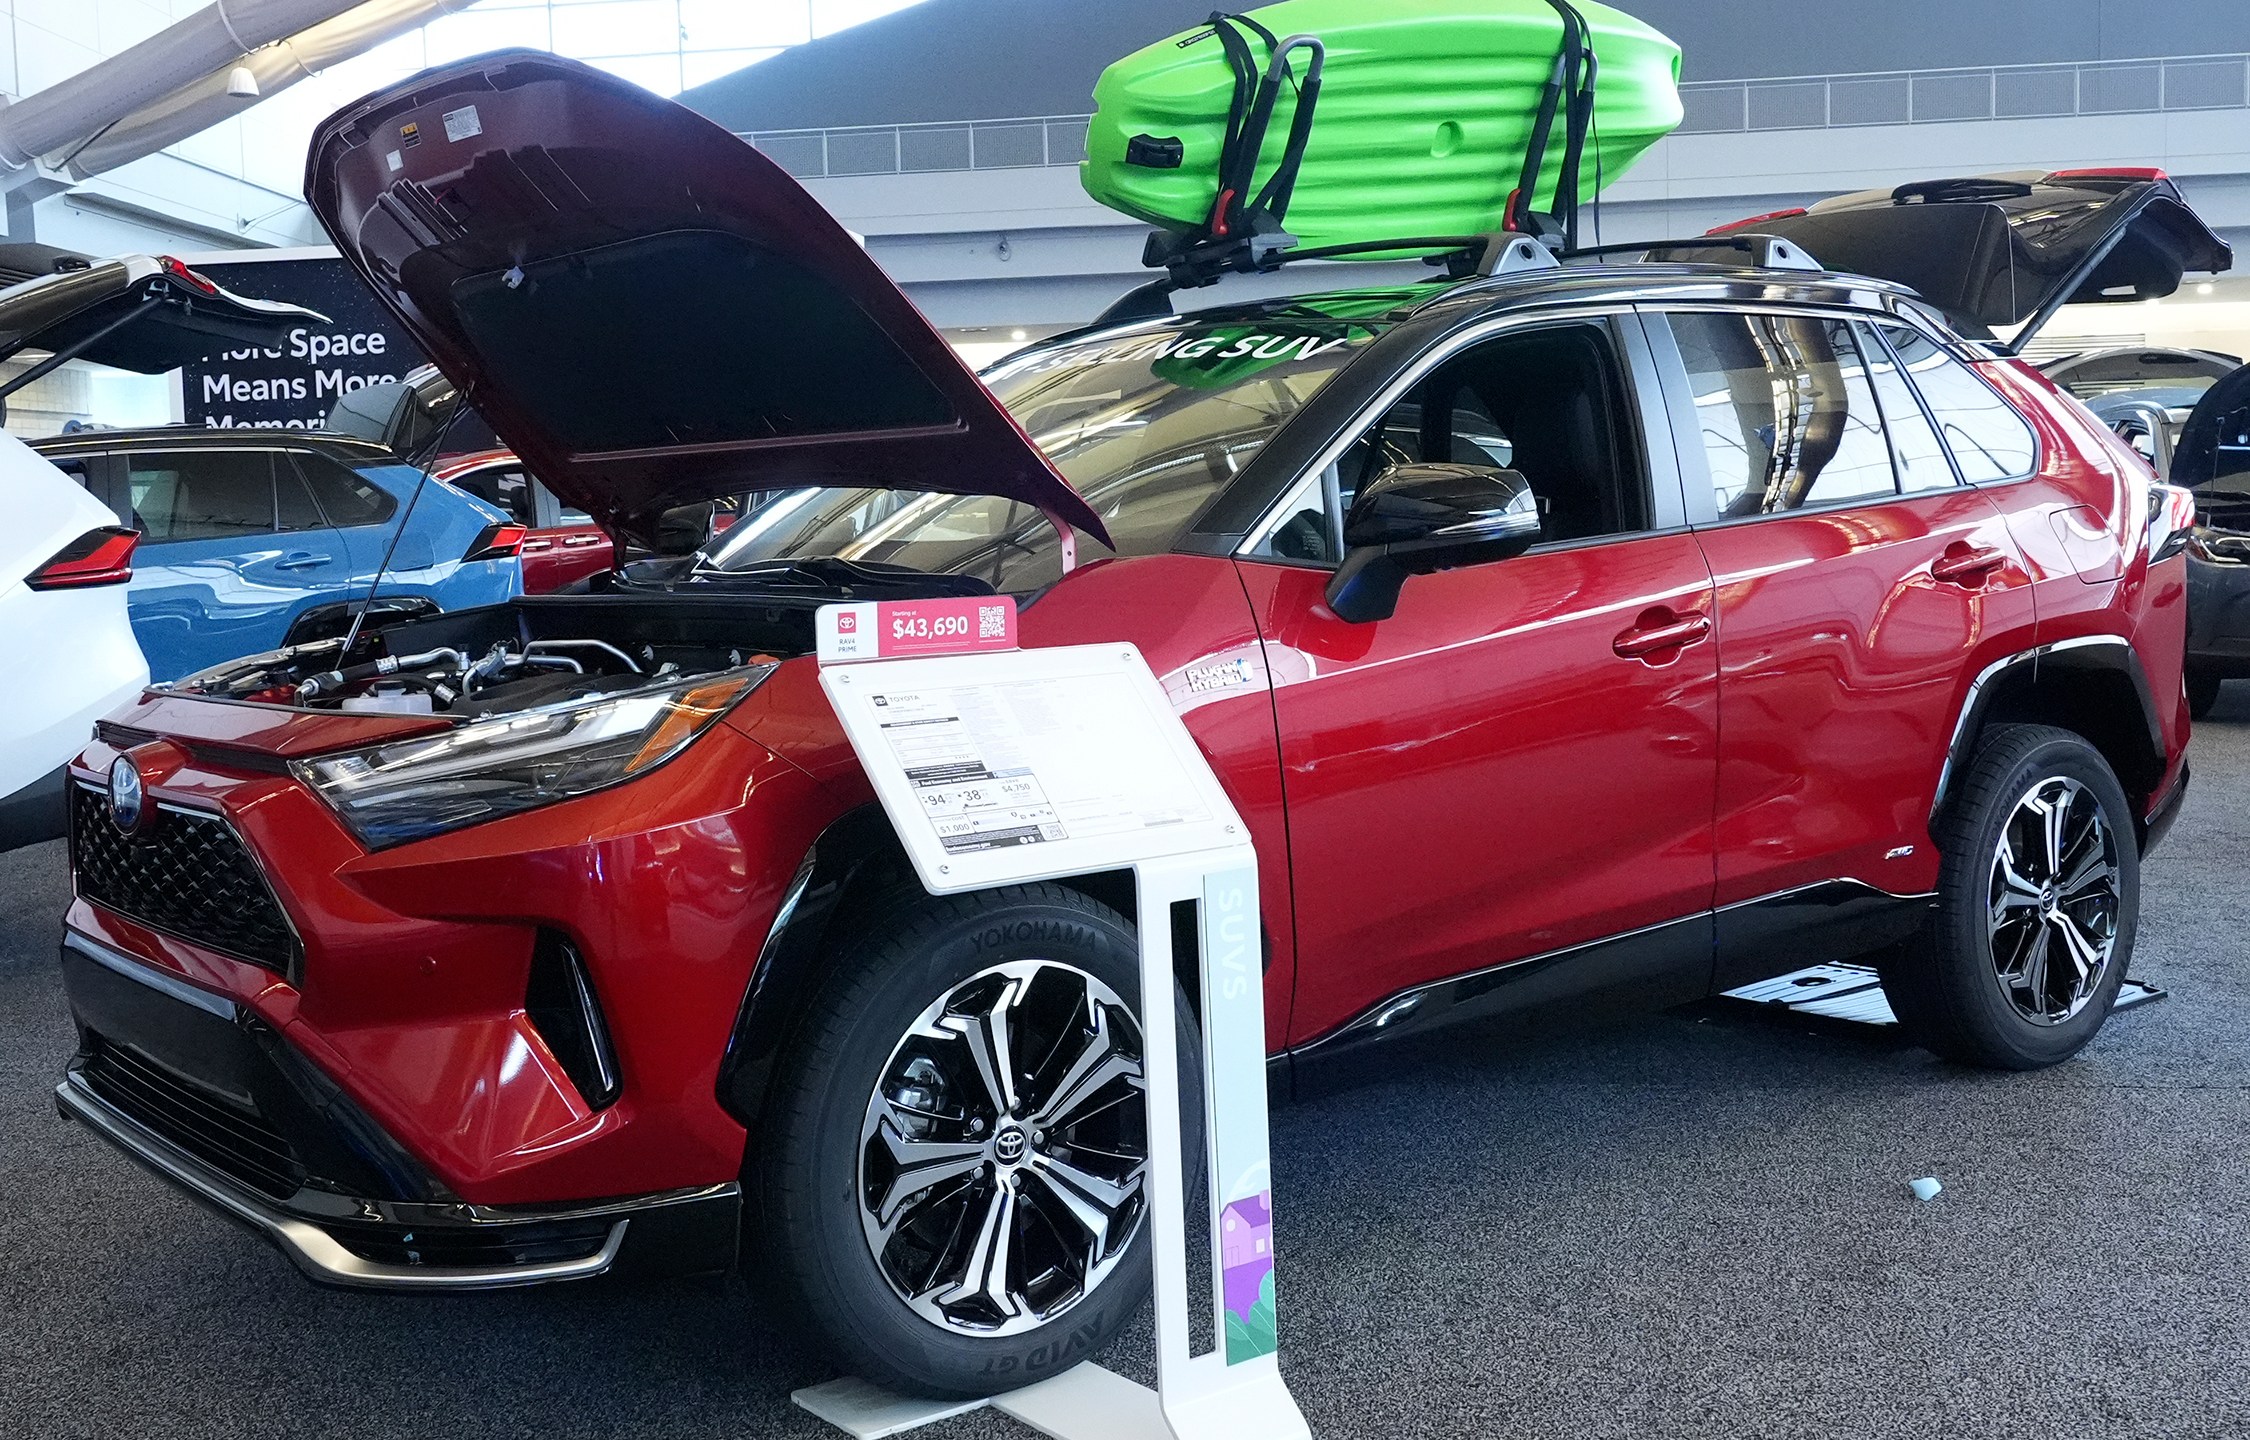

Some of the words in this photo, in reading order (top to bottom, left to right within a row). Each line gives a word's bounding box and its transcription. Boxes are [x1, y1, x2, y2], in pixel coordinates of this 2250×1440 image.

[289, 328, 386, 364] Space
[1216, 336, 1348, 361] SUV
[203, 373, 306, 403] Means
[315, 368, 397, 398] More
[893, 616, 968, 639] $43,690
[1190, 674, 1242, 692] HYBRID
[889, 695, 920, 703] TOYOTA
[928, 794, 946, 806] 94
[963, 789, 982, 801] 38
[969, 920, 1097, 953] YOKOHAMA
[1218, 888, 1247, 1000] SUVS
